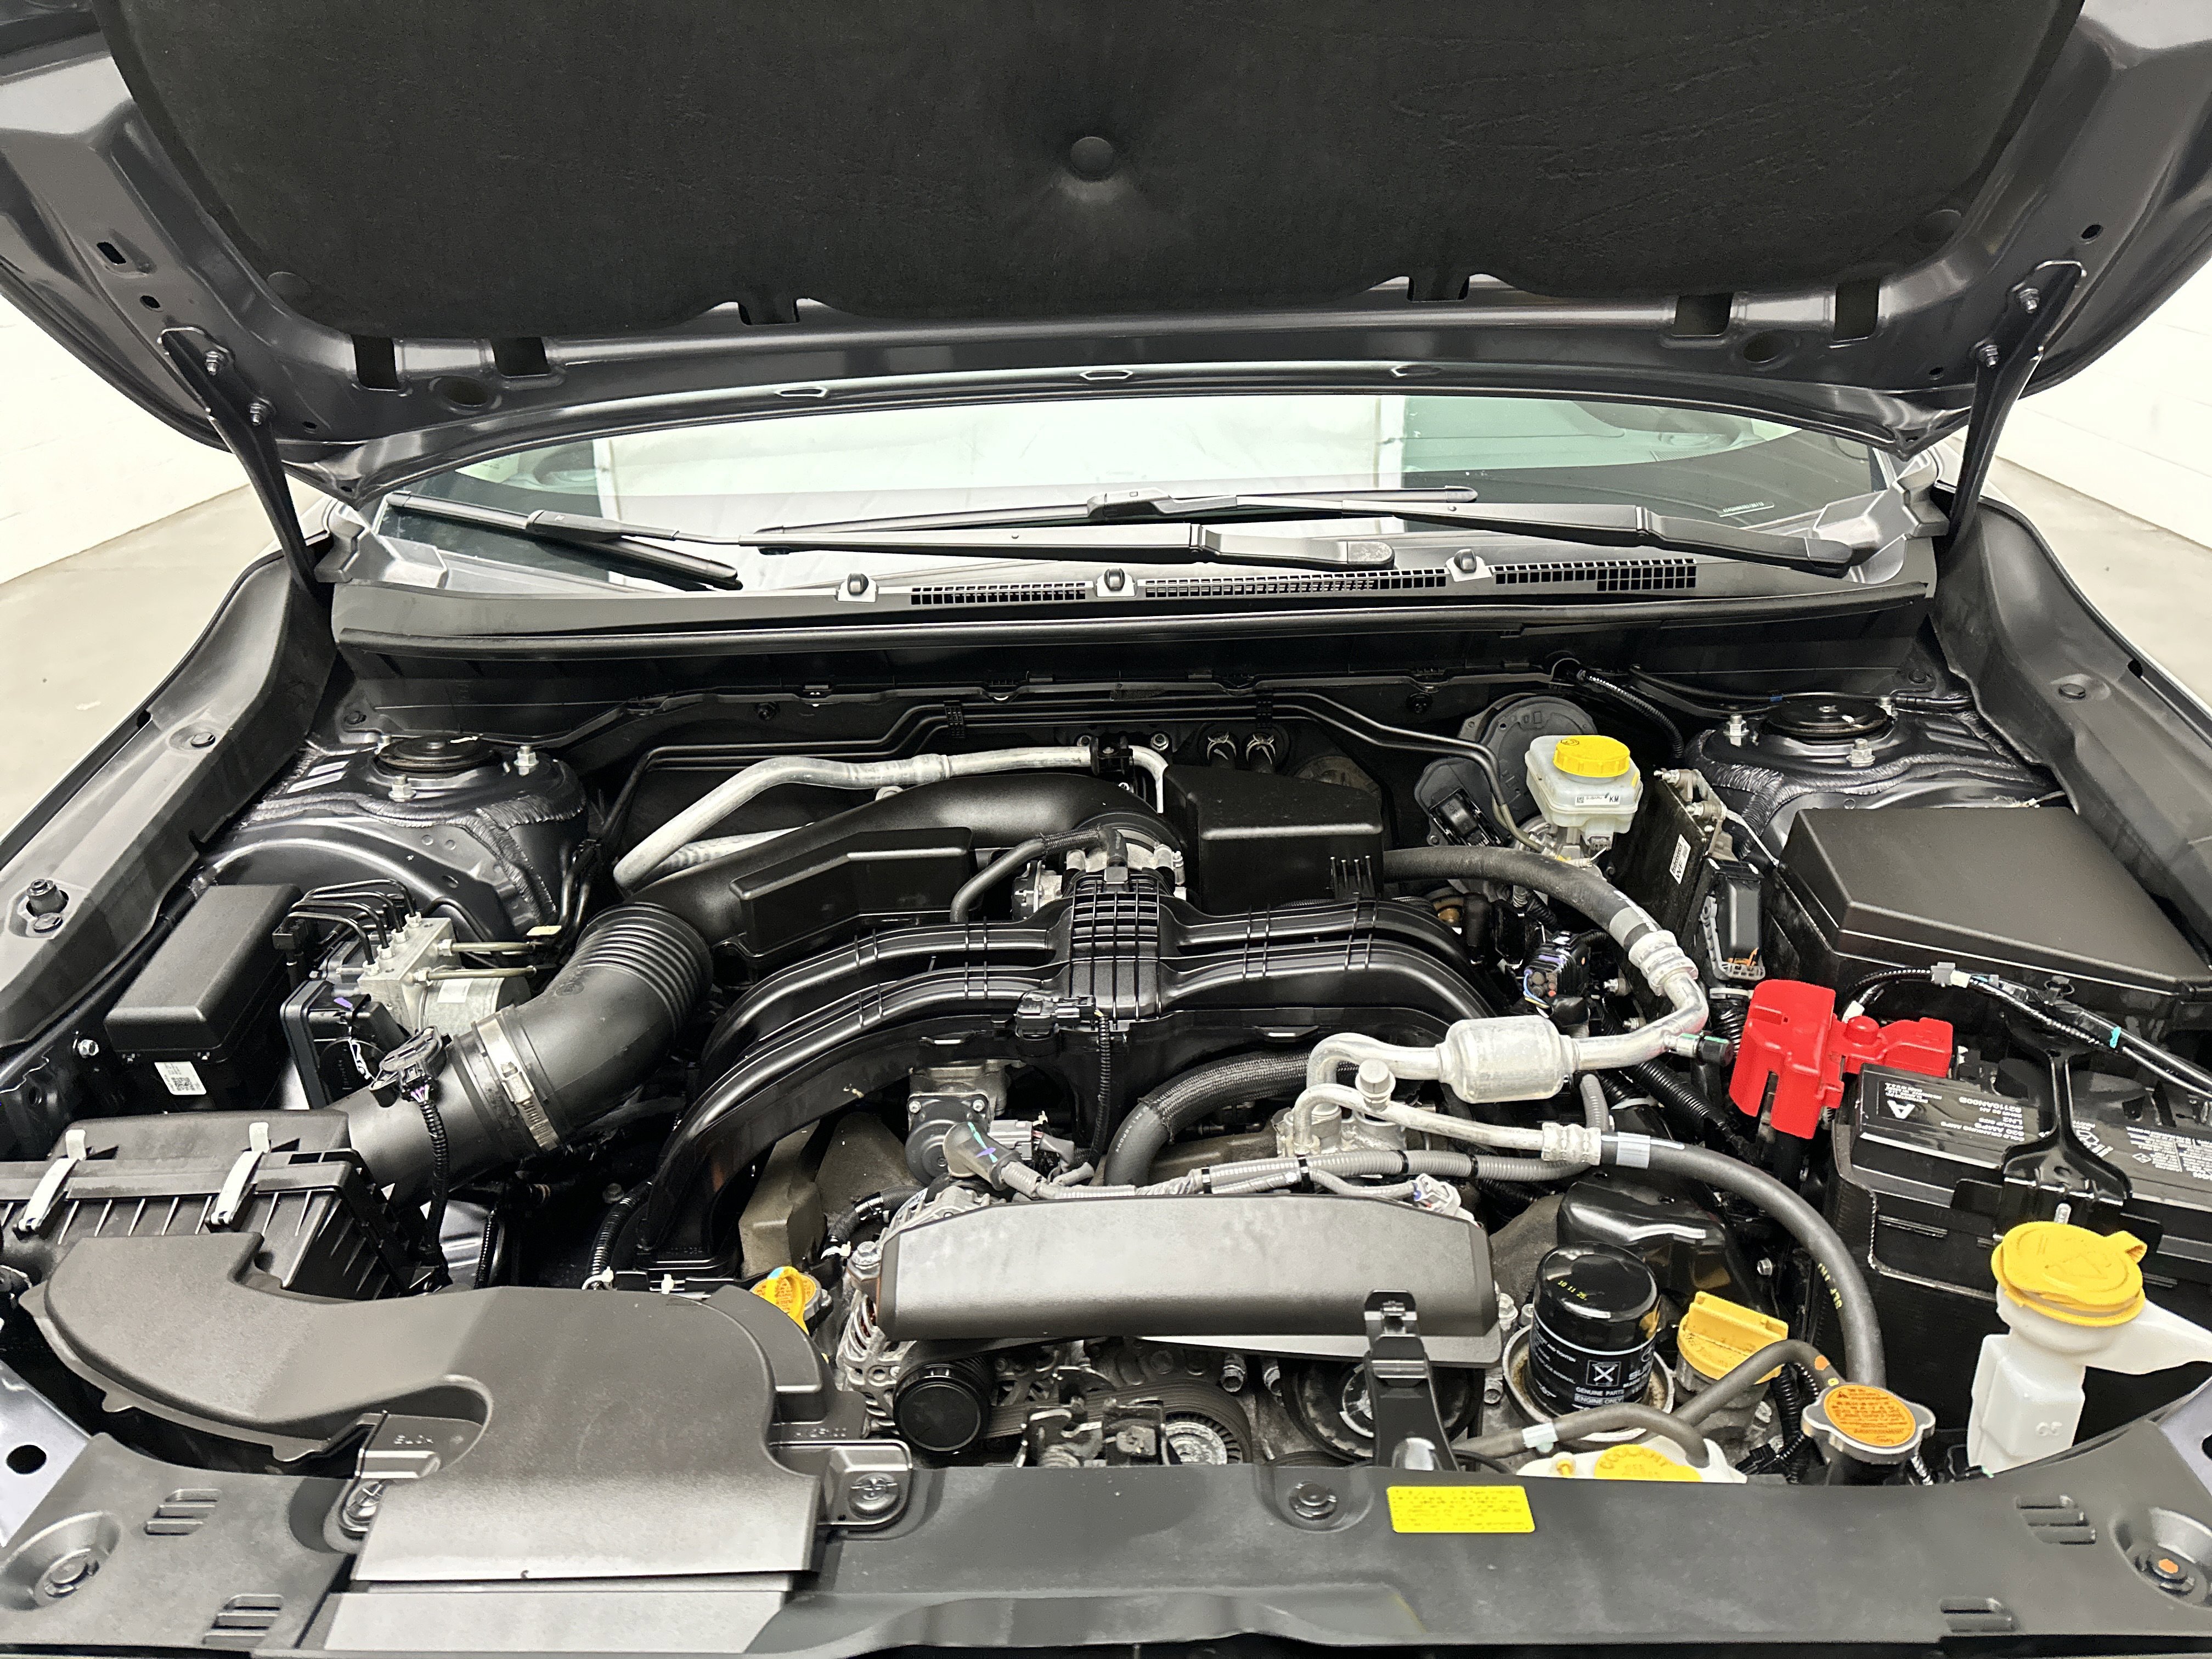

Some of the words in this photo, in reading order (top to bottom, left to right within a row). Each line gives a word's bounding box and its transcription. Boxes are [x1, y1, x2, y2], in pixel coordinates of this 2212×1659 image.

[1676, 860, 1683, 878] WF
[1974, 1122, 2005, 1133] AMPS
[1576, 1386, 1604, 1396] GENUINE
[1576, 1395, 1604, 1404] ENGINE
